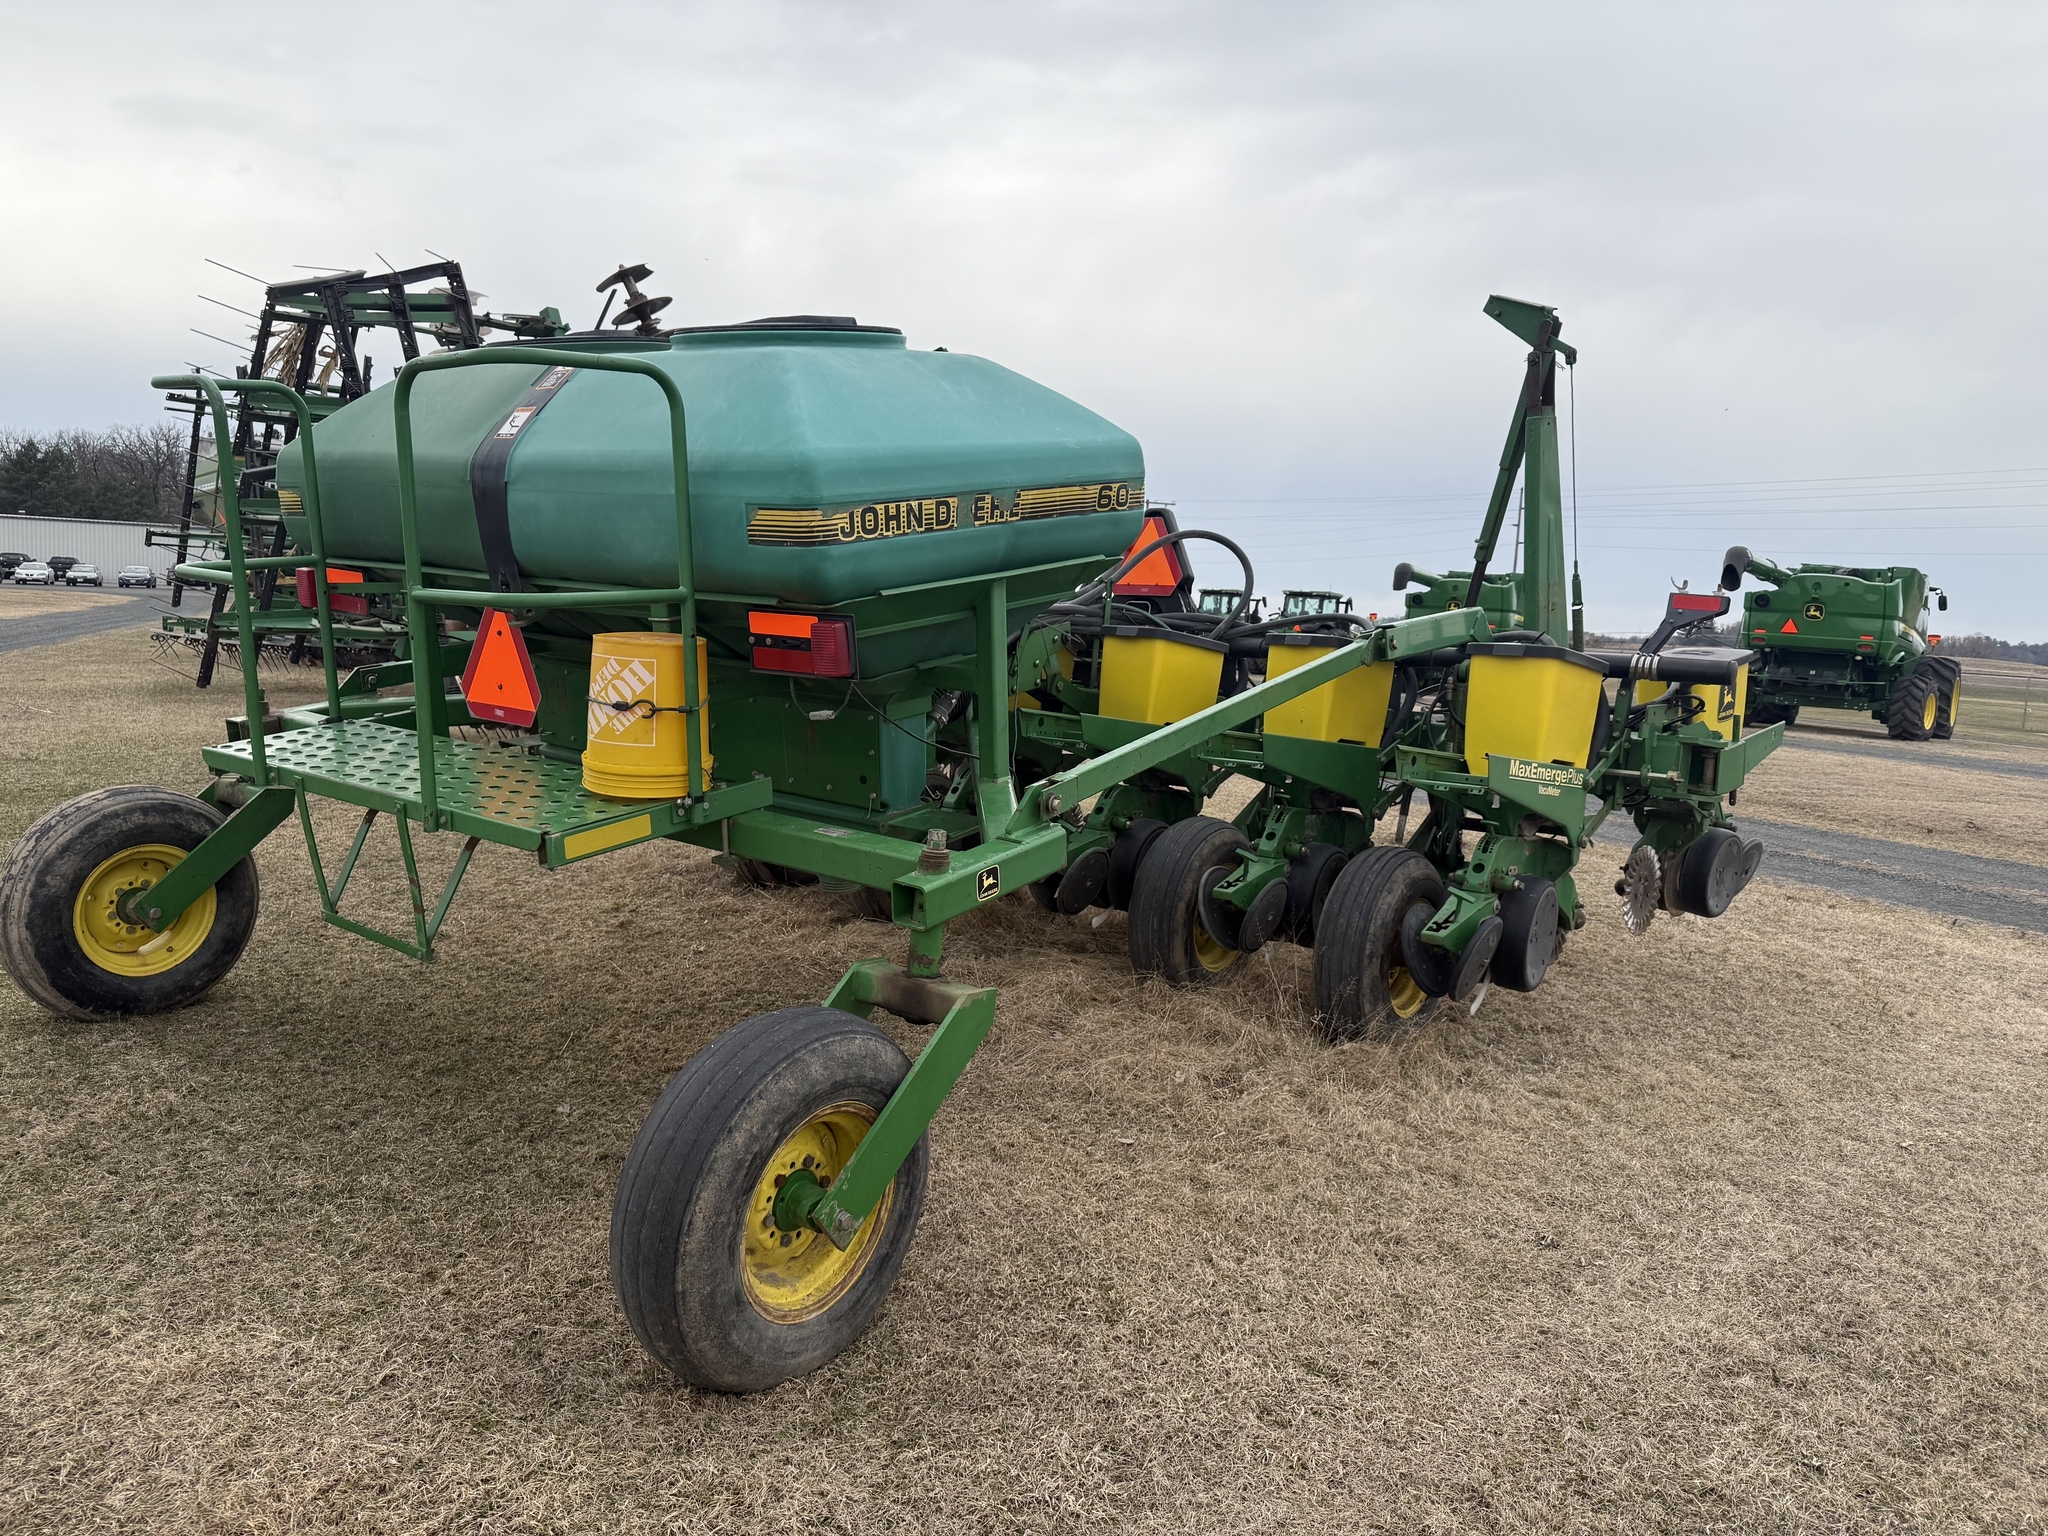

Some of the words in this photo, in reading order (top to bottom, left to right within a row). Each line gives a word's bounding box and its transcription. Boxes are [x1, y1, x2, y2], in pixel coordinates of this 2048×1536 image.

[838, 500, 925, 541] JOHN
[1096, 484, 1129, 511] 60
[589, 658, 621, 696] DEPO
[608, 705, 646, 735] THE
[1509, 759, 1584, 786] MaxEmergePlus
